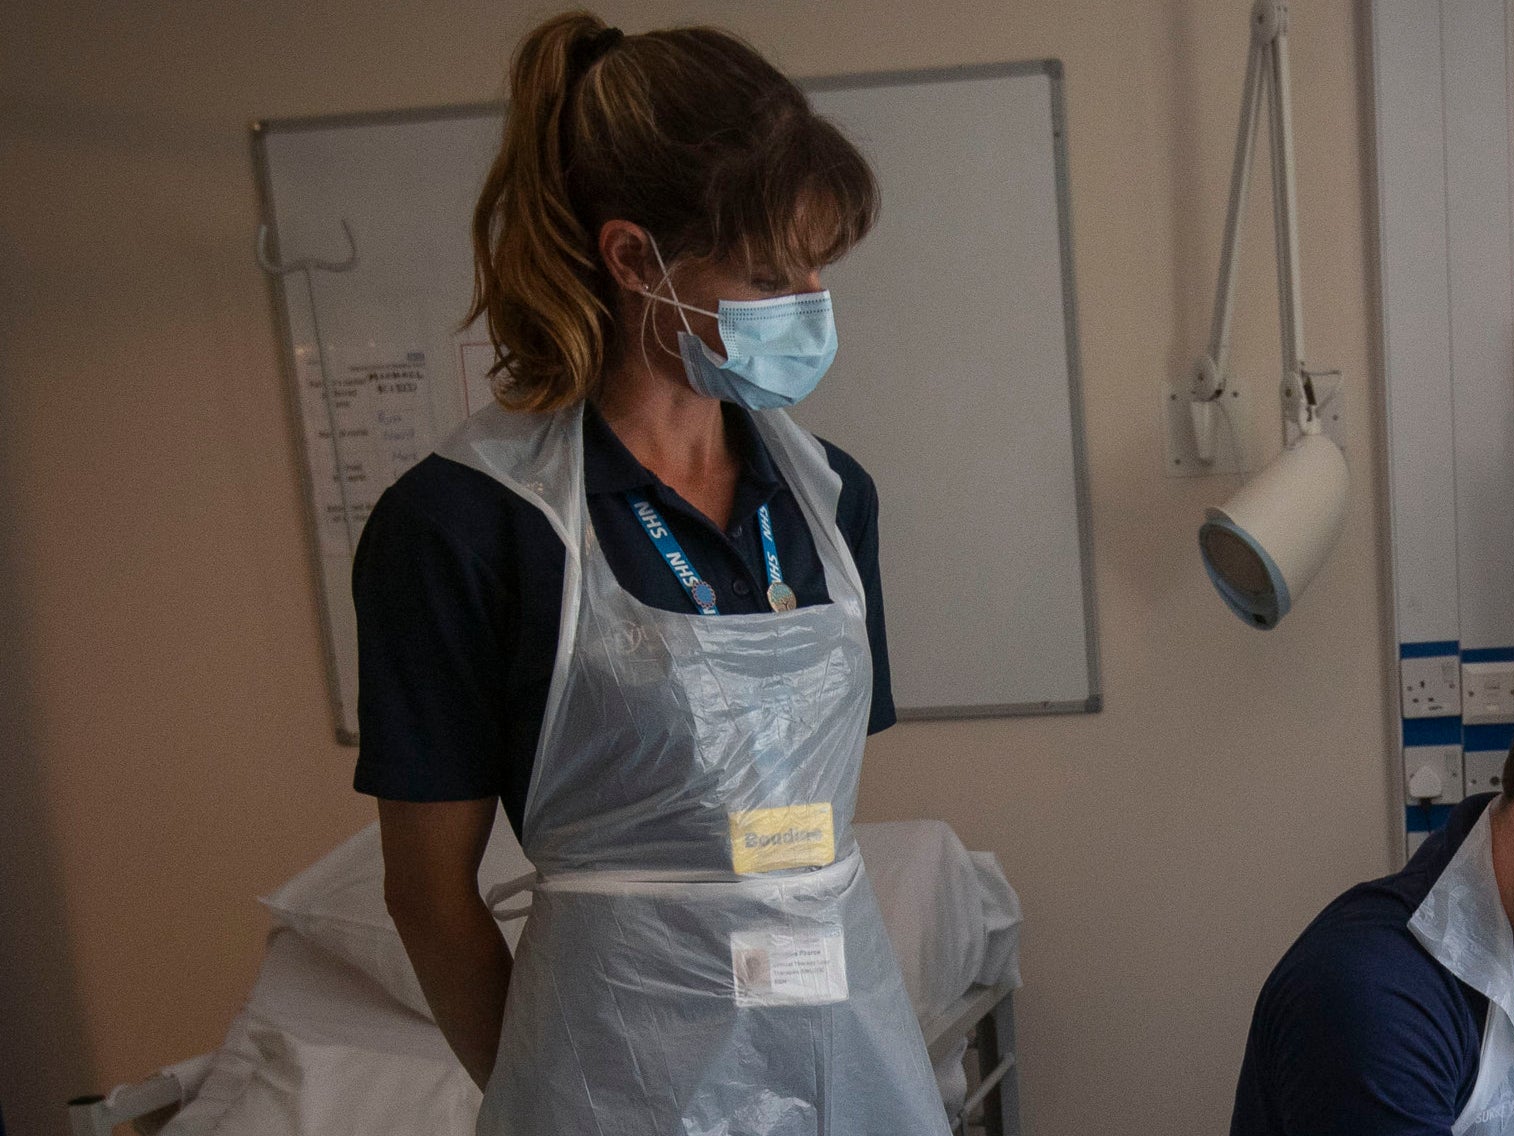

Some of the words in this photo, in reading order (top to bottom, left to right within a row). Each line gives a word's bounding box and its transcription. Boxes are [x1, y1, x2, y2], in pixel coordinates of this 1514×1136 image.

[634, 501, 668, 540] NHS
[666, 551, 699, 587] NHS
[758, 505, 773, 542] NHS
